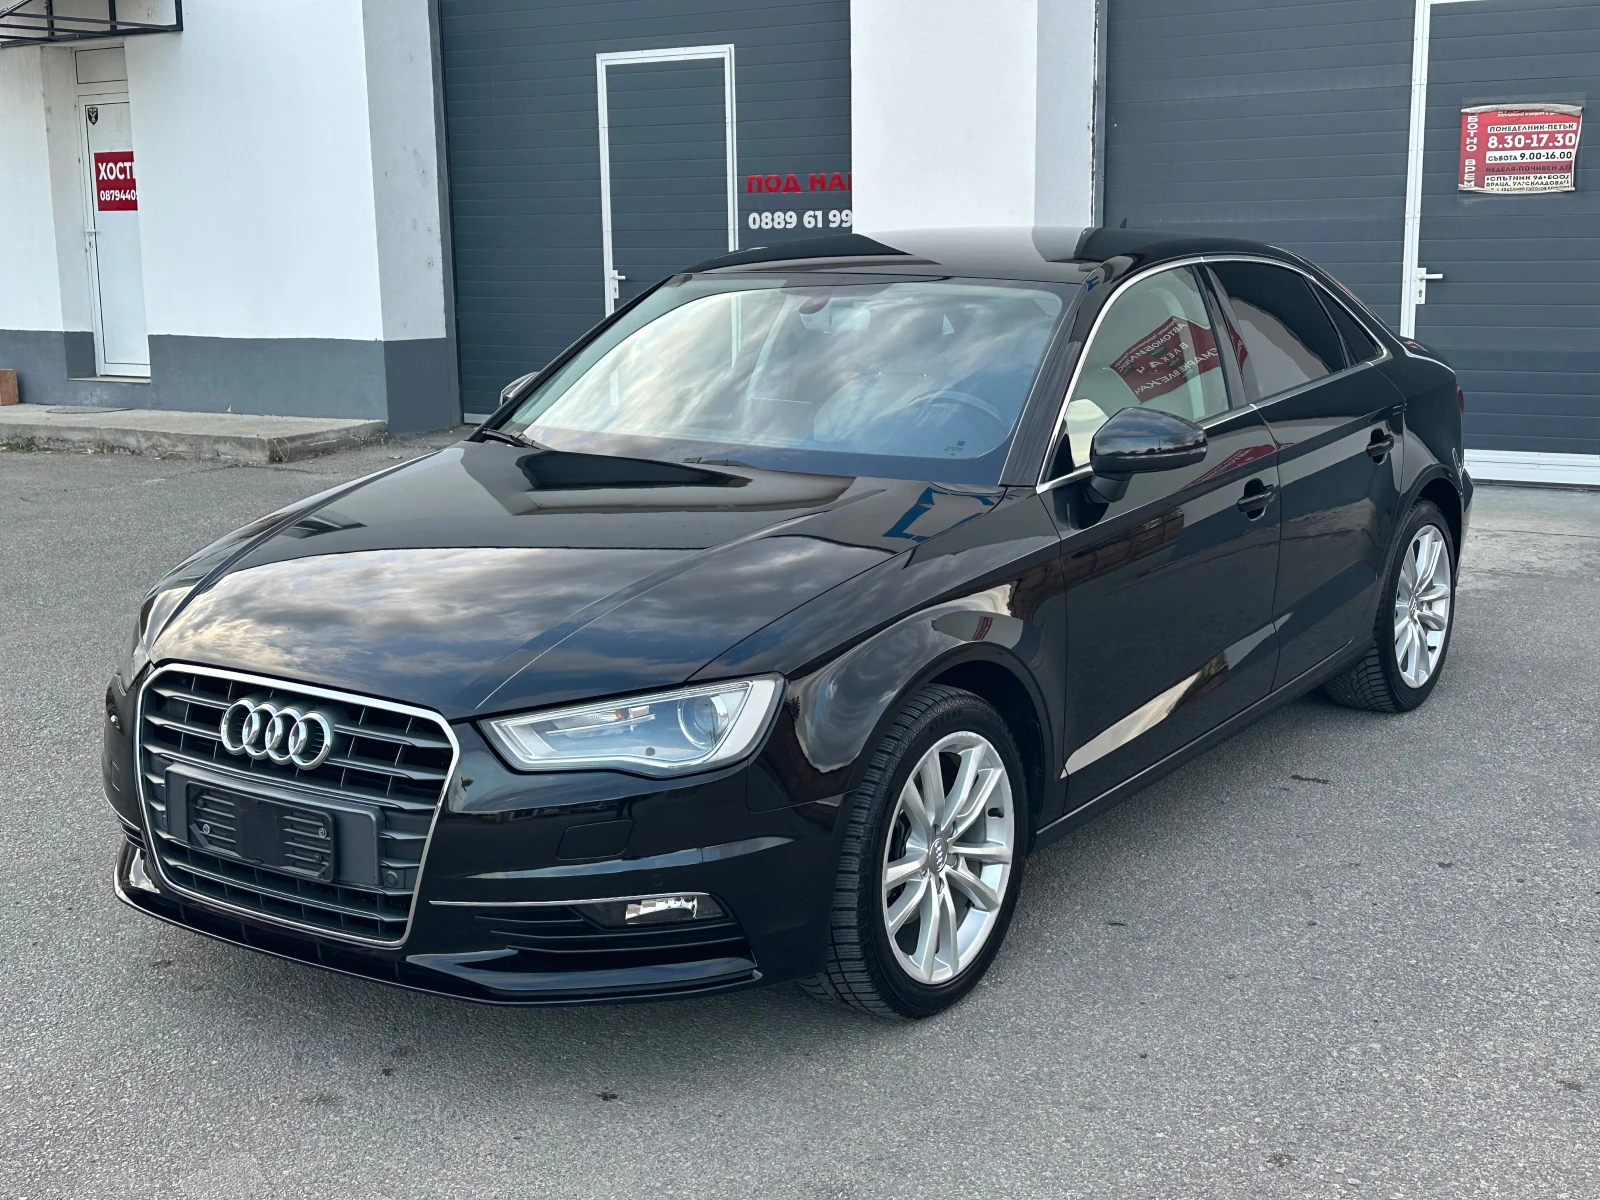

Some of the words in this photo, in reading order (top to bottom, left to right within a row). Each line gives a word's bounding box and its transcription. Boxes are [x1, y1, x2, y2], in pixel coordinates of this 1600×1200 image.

[1466, 114, 1478, 152] БОТНО
[1489, 124, 1574, 132] ПОНЕДЕЛНИК-ПЕТЪК
[1487, 133, 1576, 149] 8.30-17.30
[1488, 154, 1517, 162] СЪБОТА
[1519, 151, 1572, 160] 9.00-16.00
[746, 174, 802, 195] ПОД
[100, 189, 138, 201] 0879440
[747, 210, 797, 229] 0889
[803, 210, 823, 228] 61
[828, 209, 852, 228] 99
